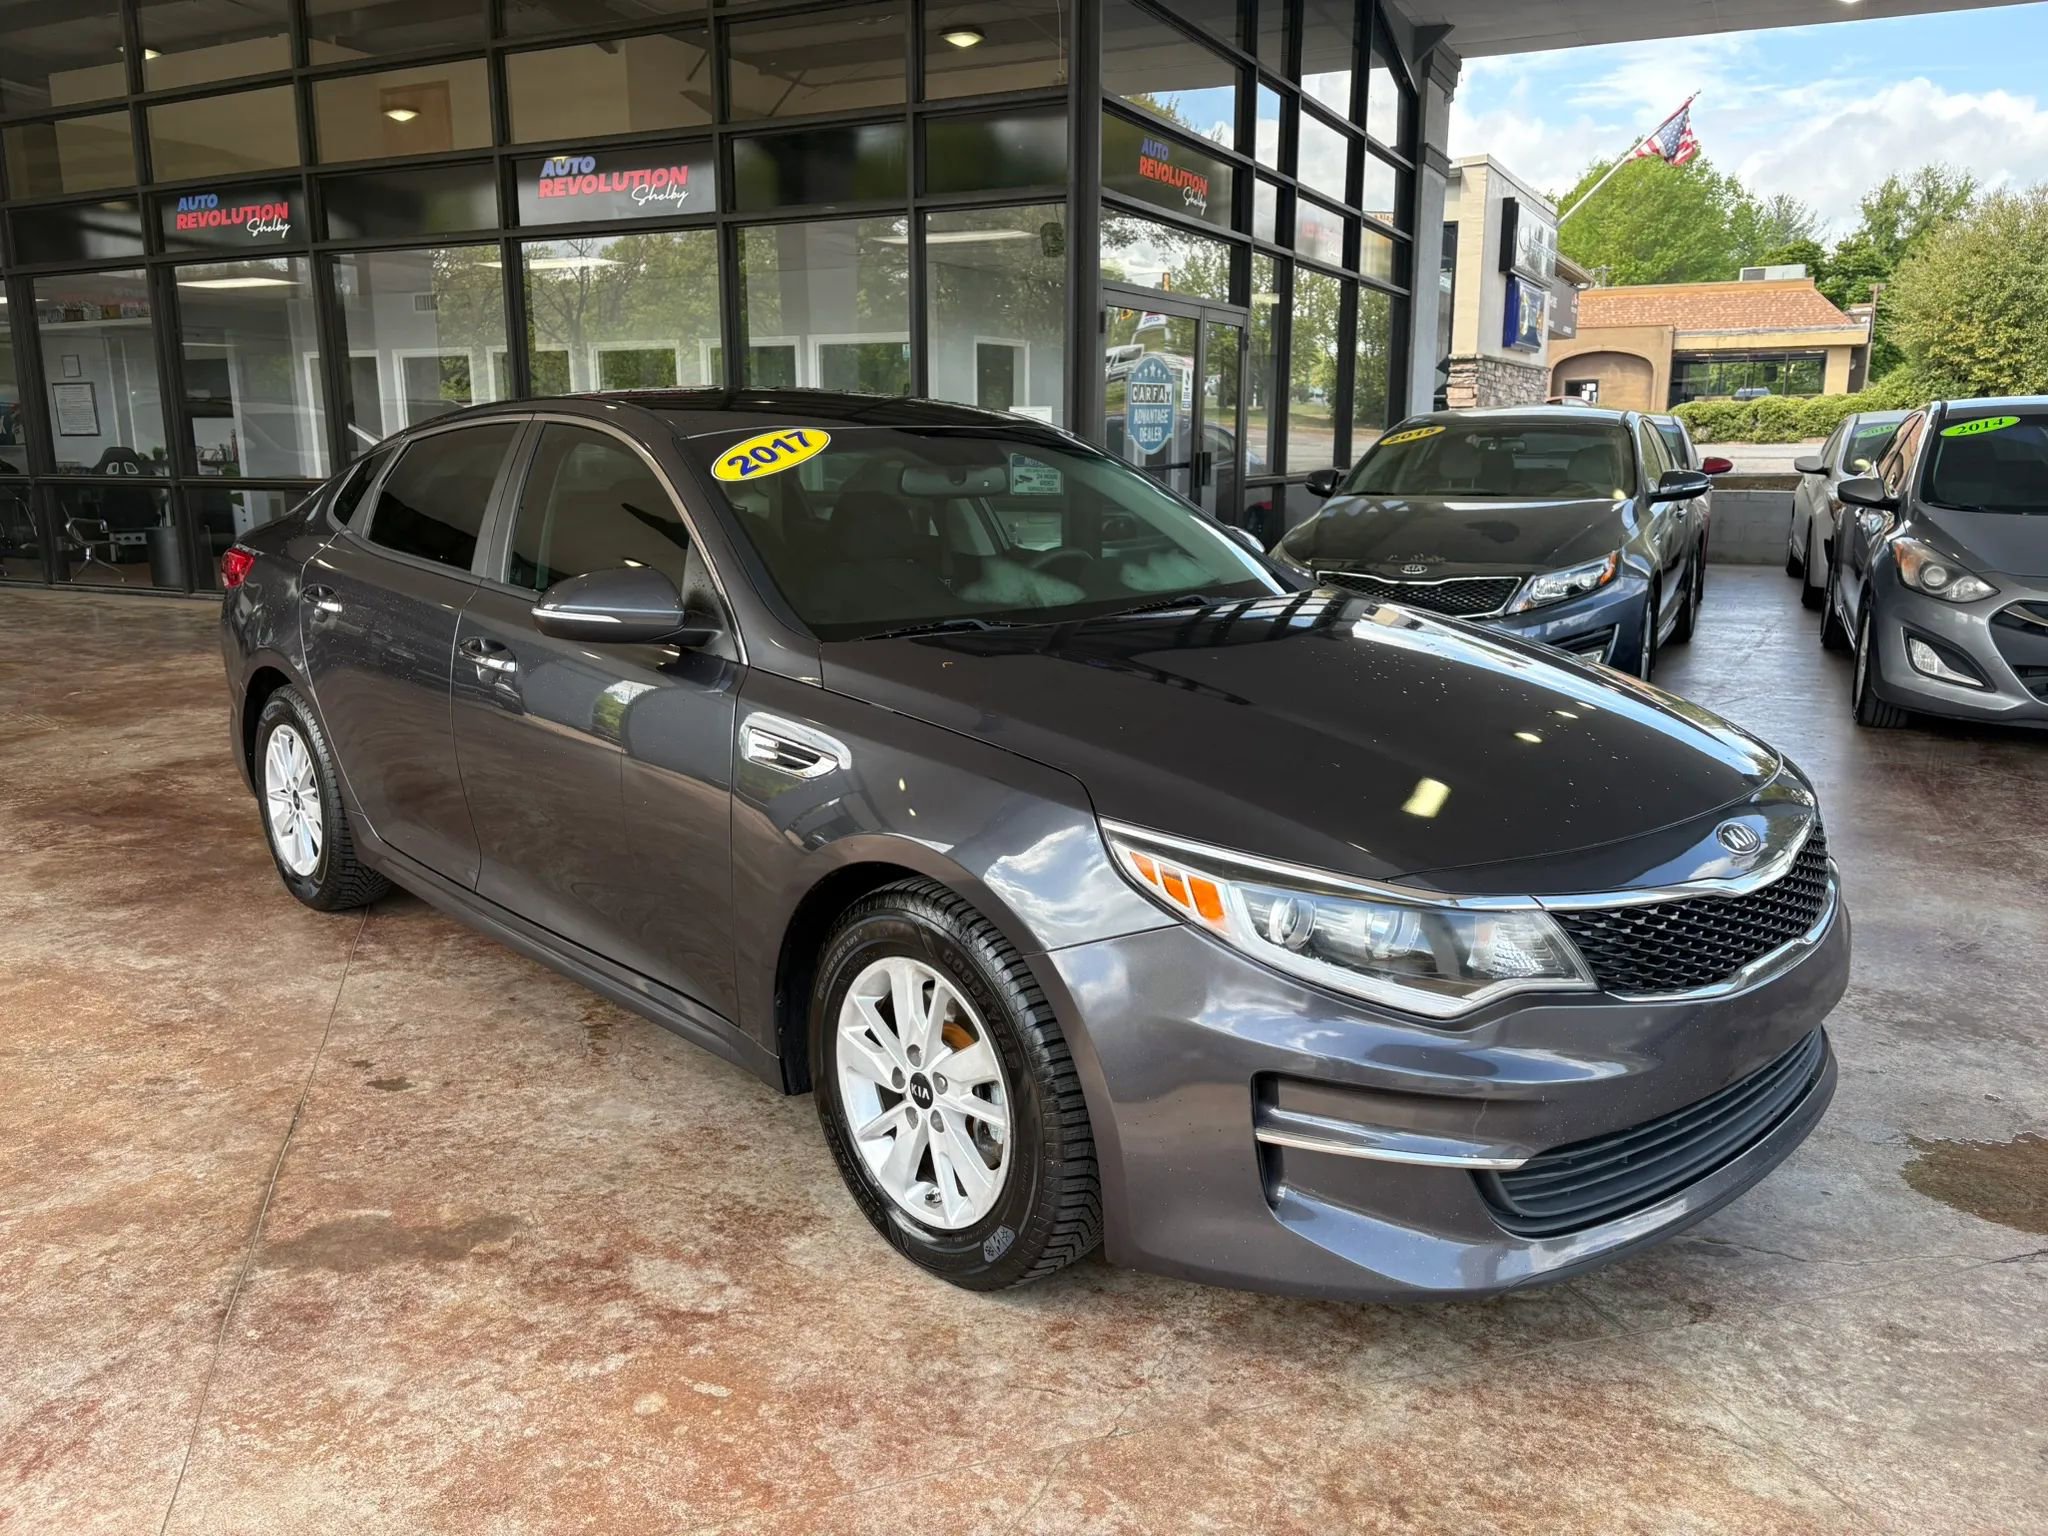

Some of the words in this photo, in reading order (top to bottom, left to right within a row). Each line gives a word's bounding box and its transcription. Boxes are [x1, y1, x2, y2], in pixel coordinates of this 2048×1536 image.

[1141, 138, 1169, 161] AUTO
[540, 156, 596, 177] AUTO
[1140, 155, 1208, 196] REVOLUTION
[539, 165, 689, 197] REVOLUTION
[177, 193, 218, 211] AUTO
[631, 180, 689, 208] Shelby
[1183, 186, 1207, 216] Shelby
[176, 202, 288, 230] REVOLUTION
[246, 214, 291, 238] Shelby
[1132, 384, 1171, 403] CARFAX
[1133, 409, 1168, 424] ADVANTAGE
[1957, 418, 2004, 434] 2014
[1139, 427, 1162, 442] DEALER
[727, 431, 811, 476] 2017
[1723, 826, 1757, 848] KIA
[911, 1083, 930, 1100] KIA
